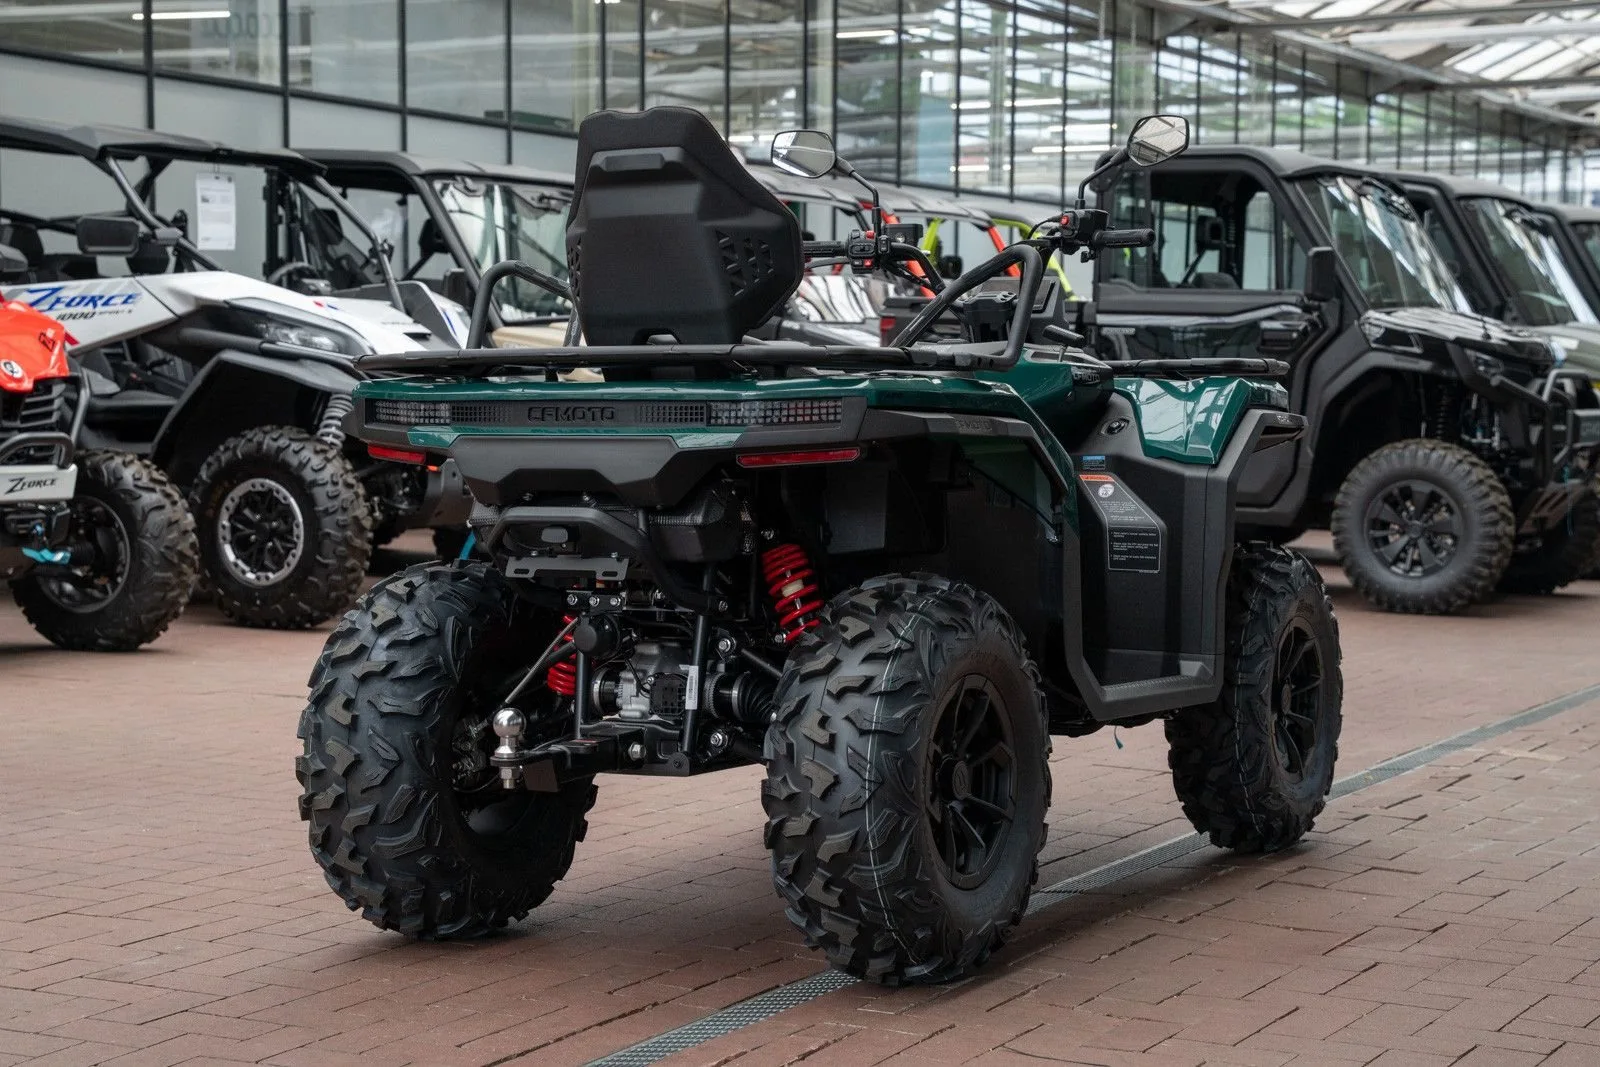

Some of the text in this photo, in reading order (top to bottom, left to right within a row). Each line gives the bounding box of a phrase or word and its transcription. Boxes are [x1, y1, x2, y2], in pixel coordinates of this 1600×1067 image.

[57, 311, 96, 322] 1000
[527, 406, 616, 422] CFMOTO
[5, 476, 58, 495] ZFORCE
